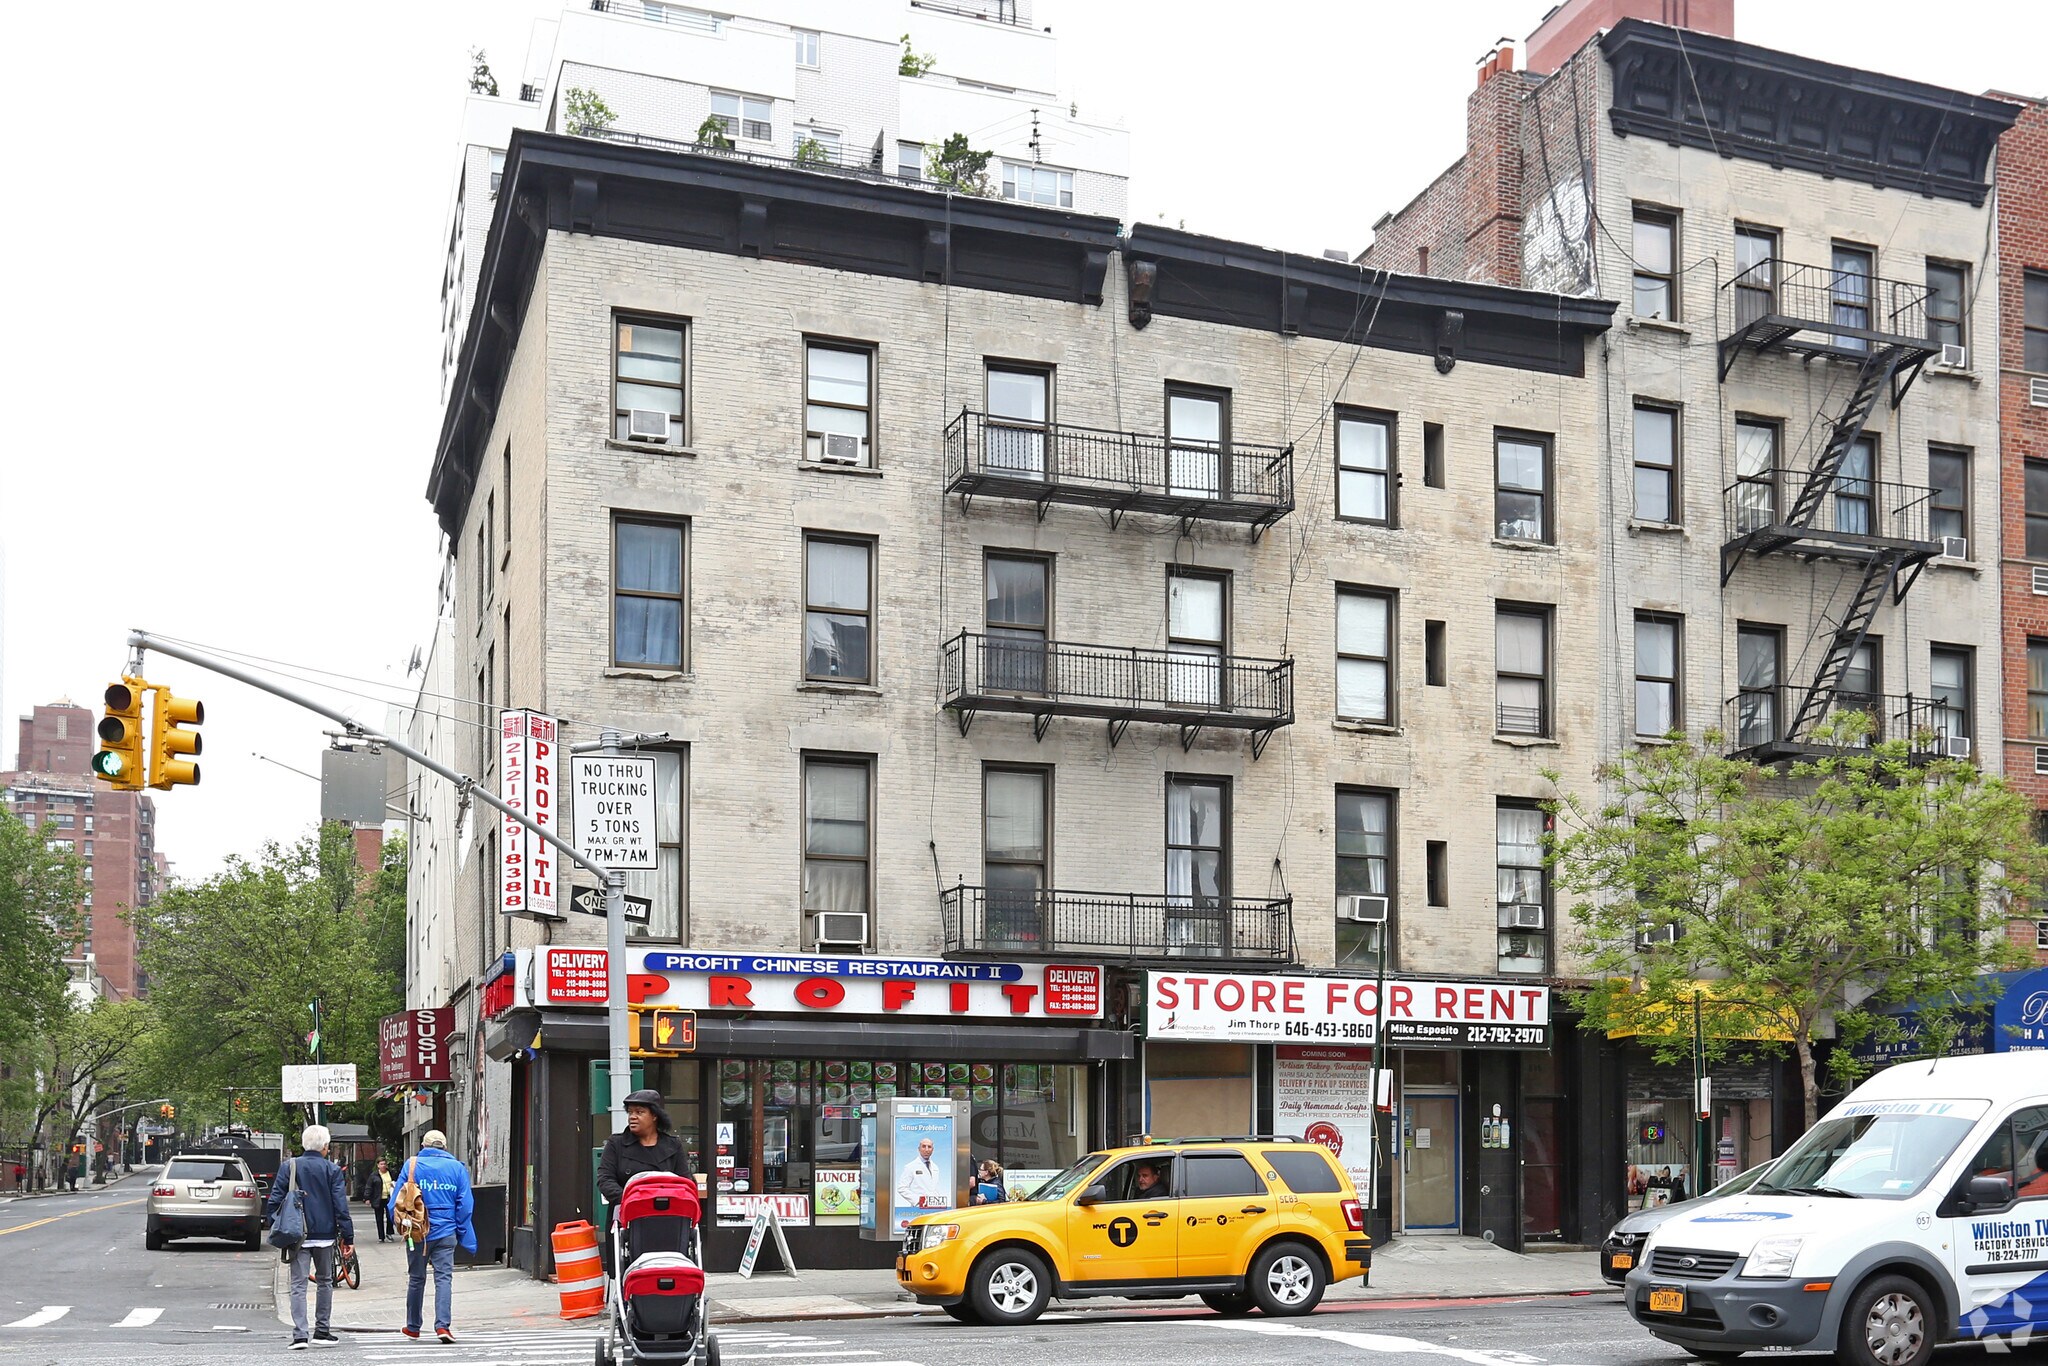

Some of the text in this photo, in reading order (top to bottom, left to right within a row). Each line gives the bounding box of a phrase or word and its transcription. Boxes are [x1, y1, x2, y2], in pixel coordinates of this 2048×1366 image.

[584, 764, 643, 778] NO THRU
[581, 782, 647, 796] TRUCKING
[535, 742, 550, 878] PROFIT
[597, 802, 632, 815] OVER
[591, 819, 640, 833] 5 TONS
[588, 837, 643, 845] MAX. GR. WT.
[583, 895, 642, 916] ONE AY
[551, 953, 606, 968] DELIVERY
[666, 956, 1002, 978] PROFIT CHINESE RESTAURANT II
[552, 969, 564, 977] TEL:
[1050, 969, 1096, 984] DELIVERY
[552, 989, 565, 997] FAX:
[627, 974, 1039, 1015] PROFIT
[1050, 984, 1061, 992] TEL:
[1156, 976, 1543, 1021] STORE FOR RENT
[383, 1017, 409, 1049] Ginza
[1228, 1019, 1373, 1039] Jim Thorp 646-453-5860
[1390, 1023, 1544, 1044] Mike Esposito 212-792-2970
[391, 1040, 407, 1059] Sushi
[416, 1010, 438, 1079] SUSHI
[1875, 1043, 1908, 1053] HAIR
[1279, 1061, 1305, 1070] Artisan
[1279, 1079, 1306, 1088] DELIVERY
[1314, 1079, 1327, 1088] PICK
[1329, 1079, 1337, 1088] UP
[912, 1105, 939, 1113] TITAN
[1279, 1101, 1302, 1112] Daily
[1303, 1101, 1343, 1111] Homemade
[1844, 1103, 1953, 1116] Williston TV
[719, 1126, 730, 1138] A
[900, 1123, 947, 1132] Sinus Problem?
[816, 1172, 856, 1183] LUNCH
[419, 1178, 458, 1193] flyi.com
[766, 1196, 805, 1217] ATM
[1918, 1216, 1930, 1224] 057
[1972, 1219, 2030, 1239] Williston
[1975, 1240, 2013, 1251] FACTORY
[1987, 1249, 2039, 1262] 718-224-7777
